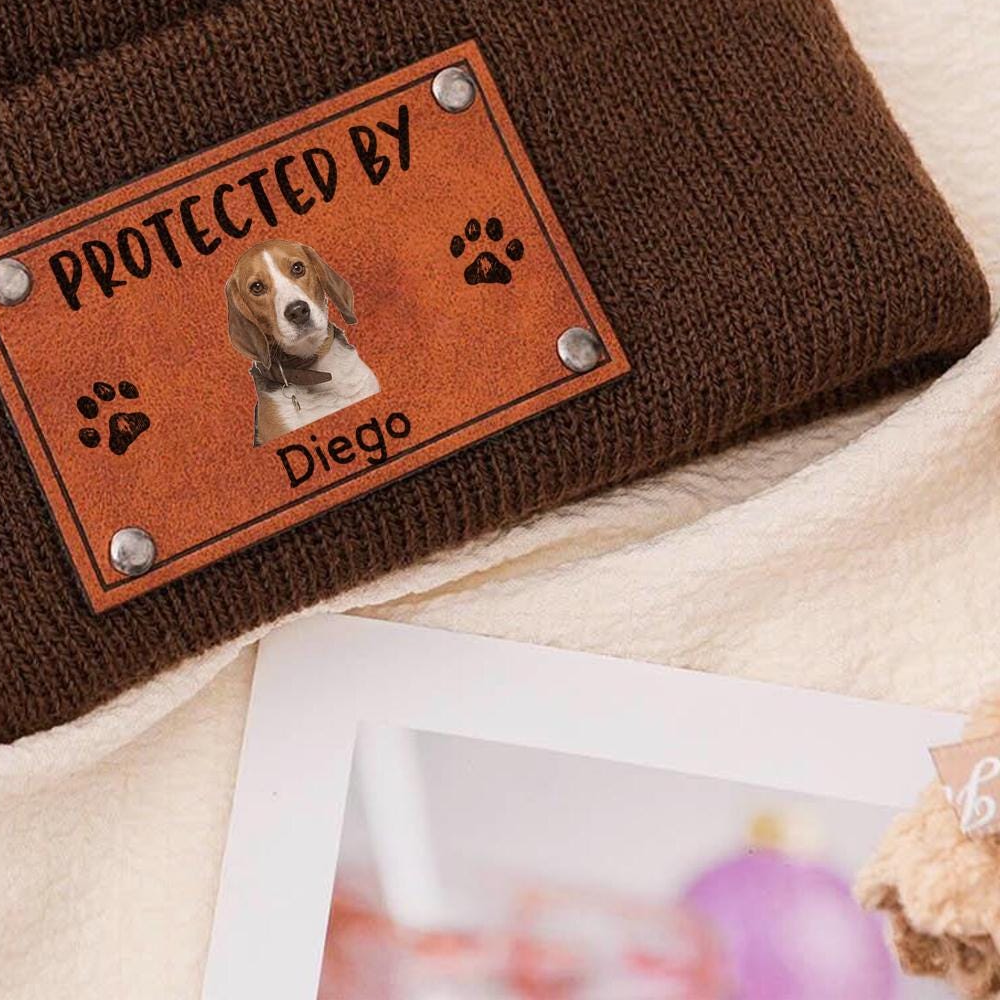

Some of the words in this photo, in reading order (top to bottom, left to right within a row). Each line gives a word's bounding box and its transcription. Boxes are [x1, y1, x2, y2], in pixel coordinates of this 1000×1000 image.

[49, 147, 337, 309] PROTECTED
[349, 105, 410, 185] BY
[278, 412, 411, 488] Diego
